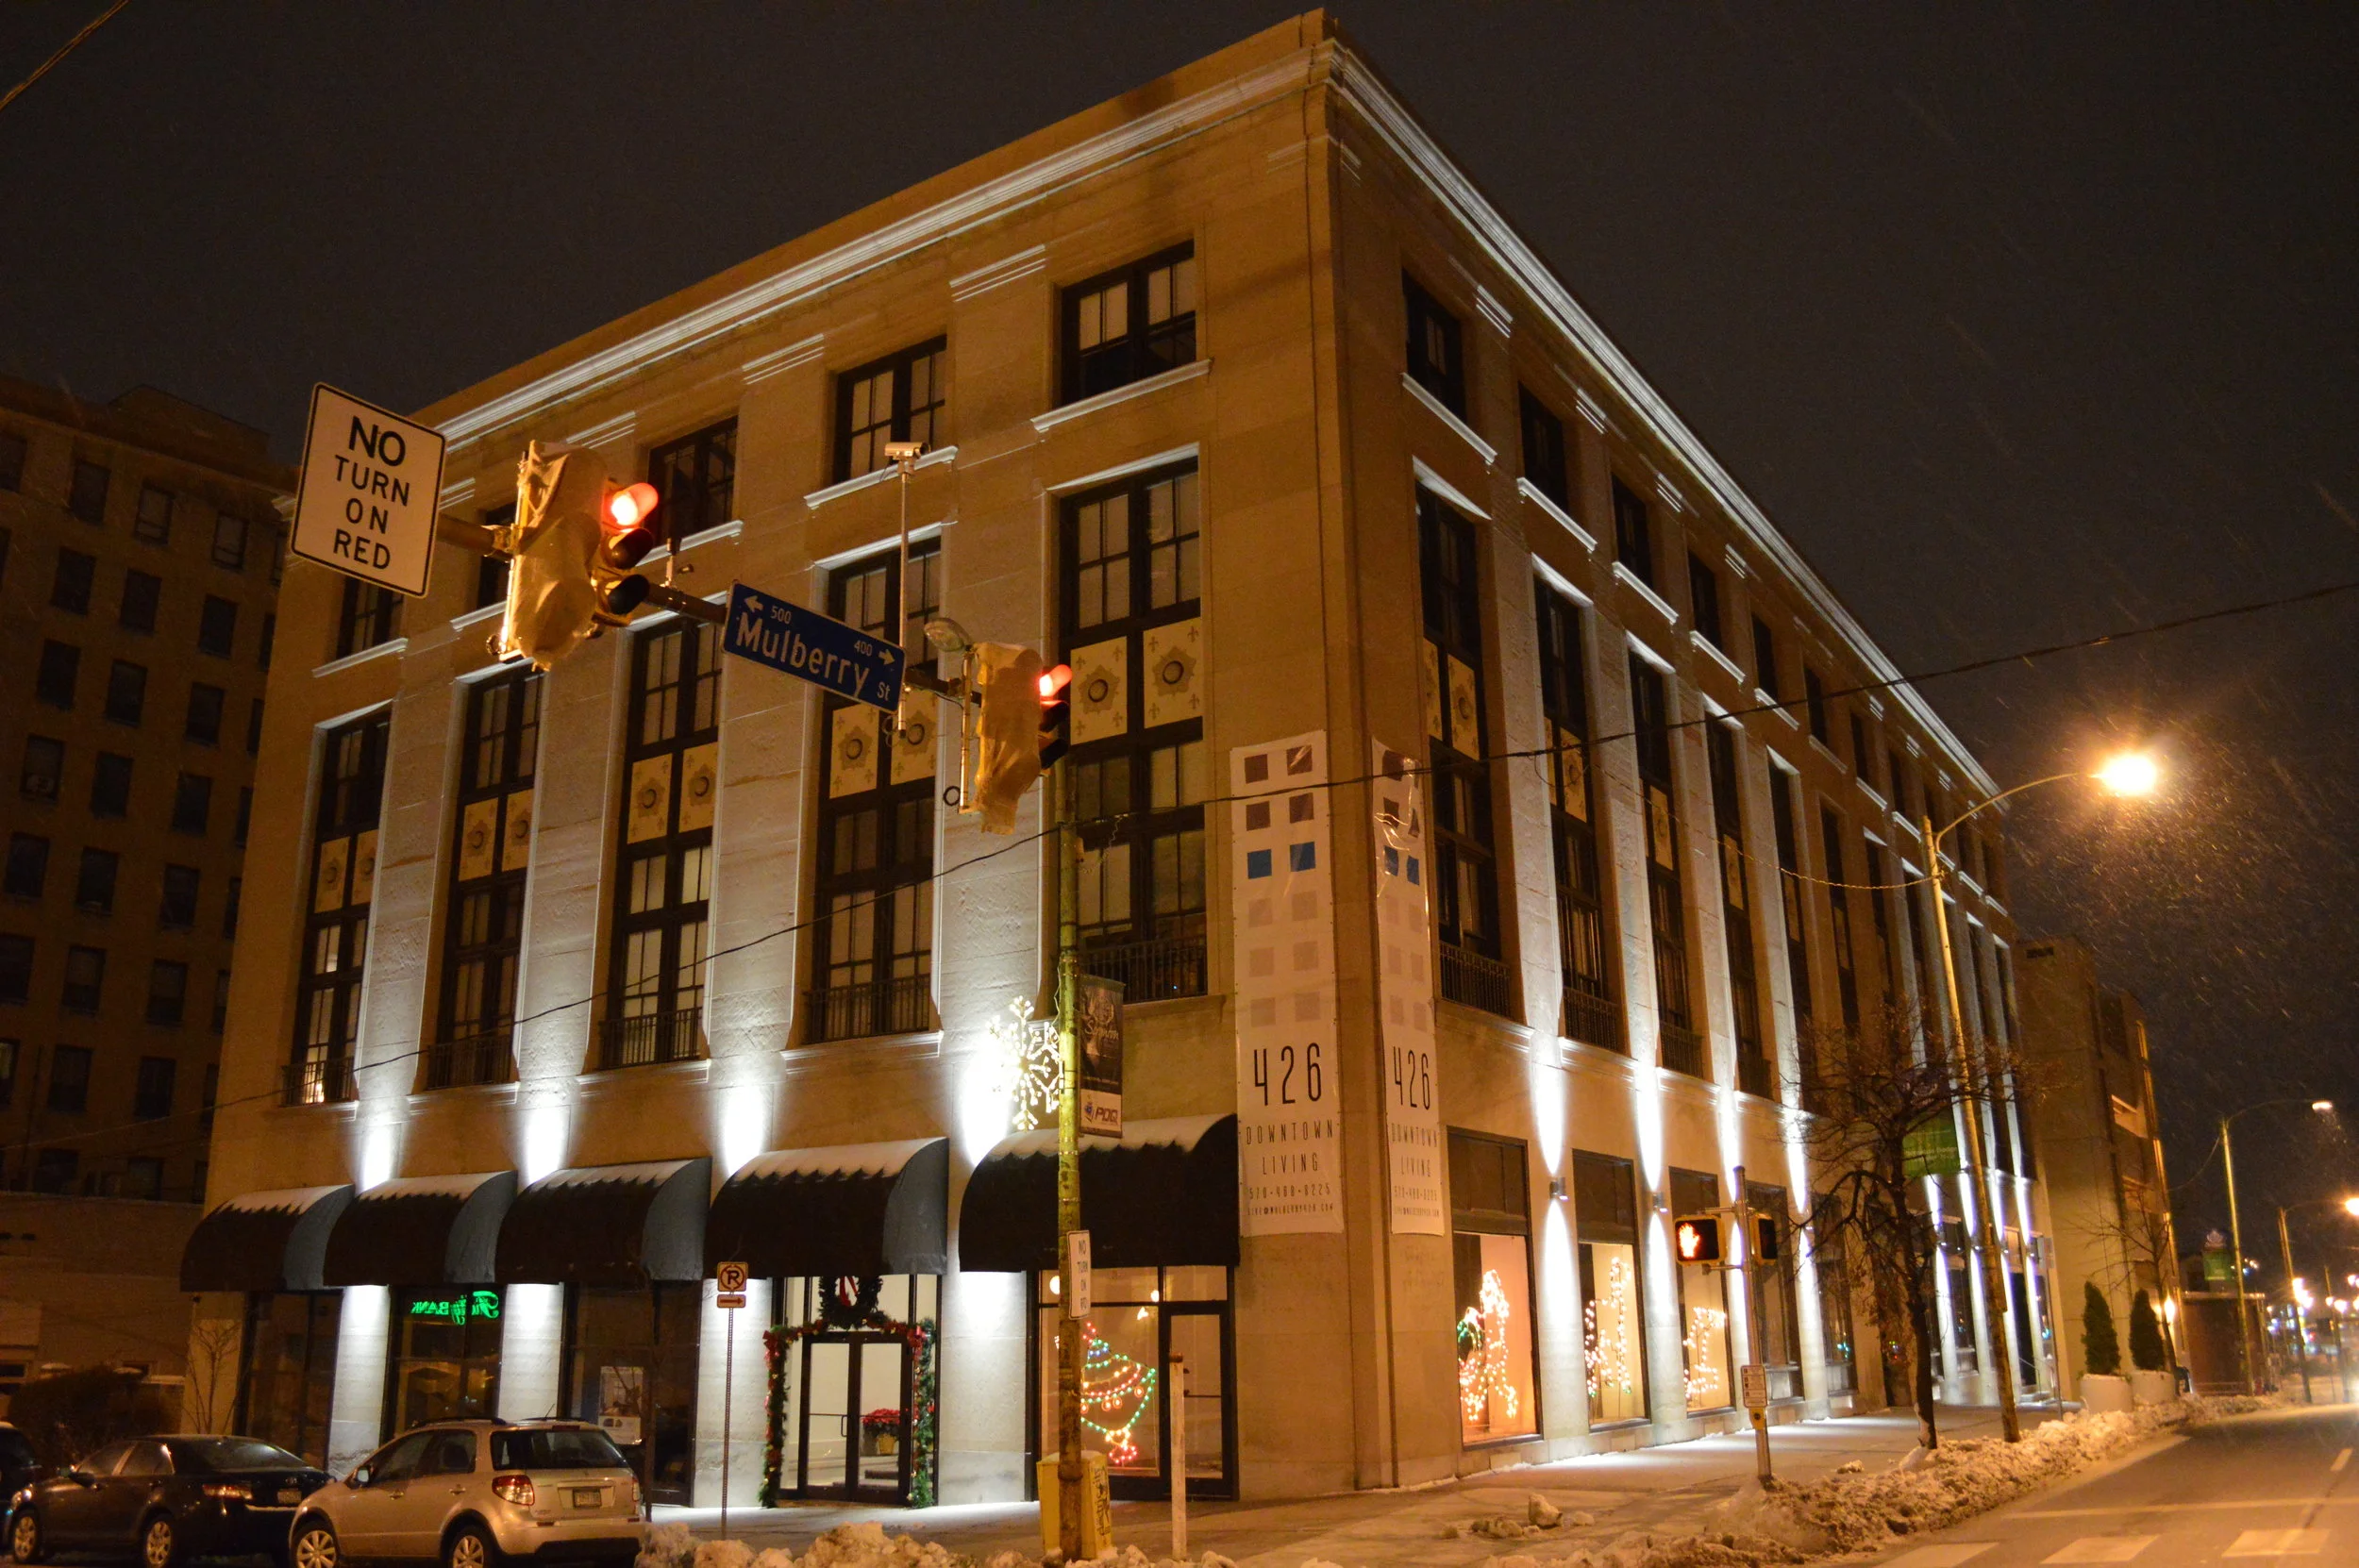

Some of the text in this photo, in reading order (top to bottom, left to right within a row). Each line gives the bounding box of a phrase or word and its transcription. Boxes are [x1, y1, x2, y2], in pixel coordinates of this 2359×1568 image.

[349, 416, 406, 467] NO
[335, 455, 410, 507] TURN
[345, 498, 389, 534] ON
[333, 529, 391, 570] RED
[771, 606, 873, 657] 500 400
[736, 611, 891, 702] Mulberry St
[1253, 1043, 1322, 1106] 426
[1393, 1045, 1430, 1110] 426
[1246, 1120, 1333, 1145] DOWNTOWN
[1392, 1123, 1437, 1147] DOWNTOWN
[1262, 1153, 1318, 1176] LIVING
[1401, 1155, 1430, 1177] LIVING
[1079, 1240, 1086, 1255] NO
